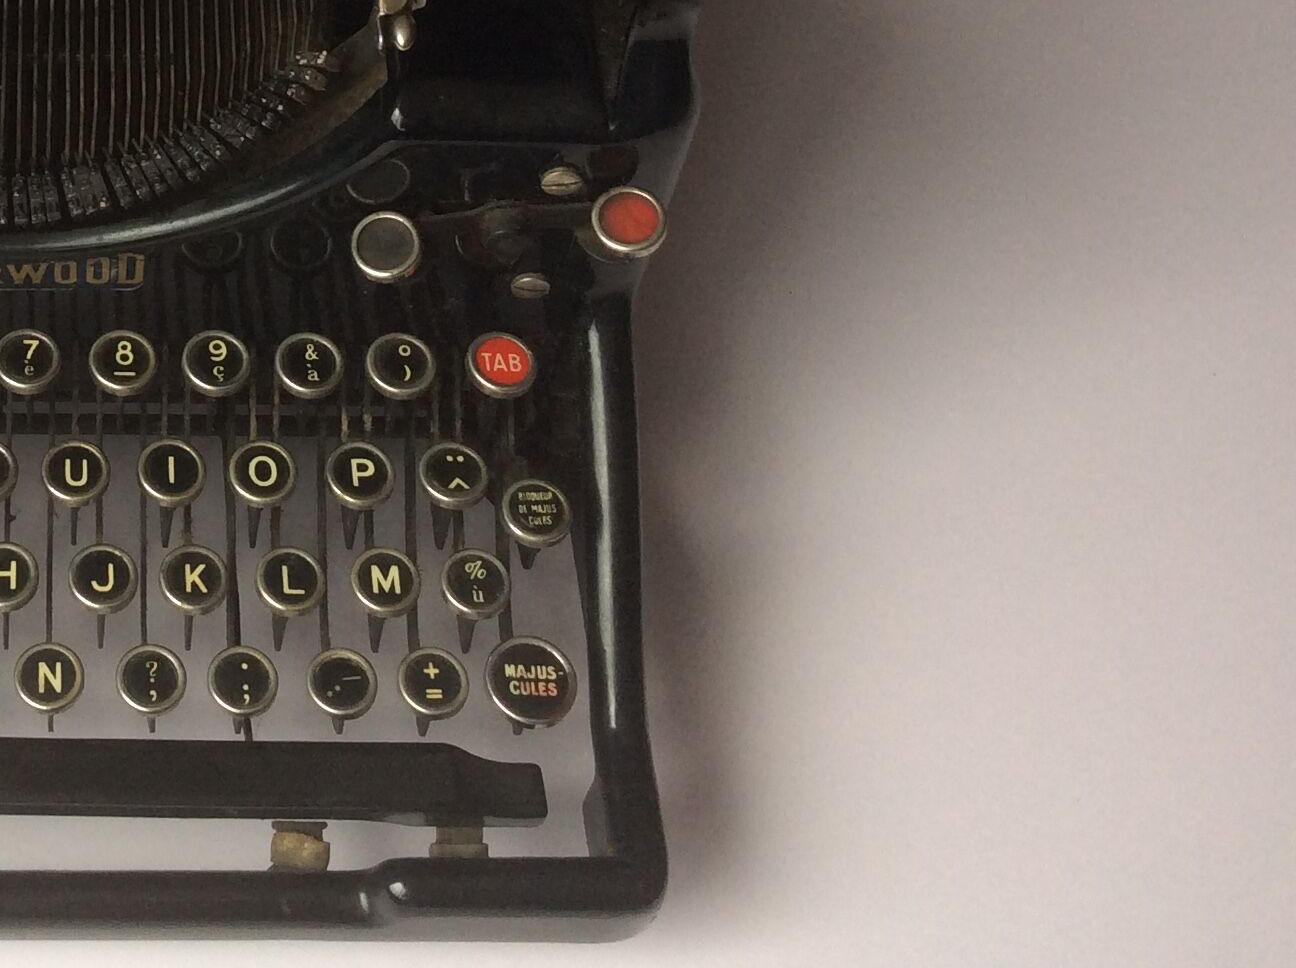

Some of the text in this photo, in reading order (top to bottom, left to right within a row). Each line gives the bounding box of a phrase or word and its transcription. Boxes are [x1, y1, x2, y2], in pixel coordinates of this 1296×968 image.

[23, 340, 40, 359] 7
[115, 340, 134, 365] 8
[209, 340, 228, 361] 9
[304, 343, 319, 360] &
[481, 351, 522, 373] TAB
[212, 365, 225, 382] ç
[64, 458, 88, 487] U
[168, 456, 175, 484] I
[248, 455, 278, 487] O
[350, 458, 375, 487] P
[91, 563, 114, 592] J
[184, 563, 208, 593] K
[281, 565, 306, 595] L
[370, 564, 401, 595] M
[464, 559, 487, 580] %
[38, 661, 62, 694] N
[509, 680, 559, 698] CULES
